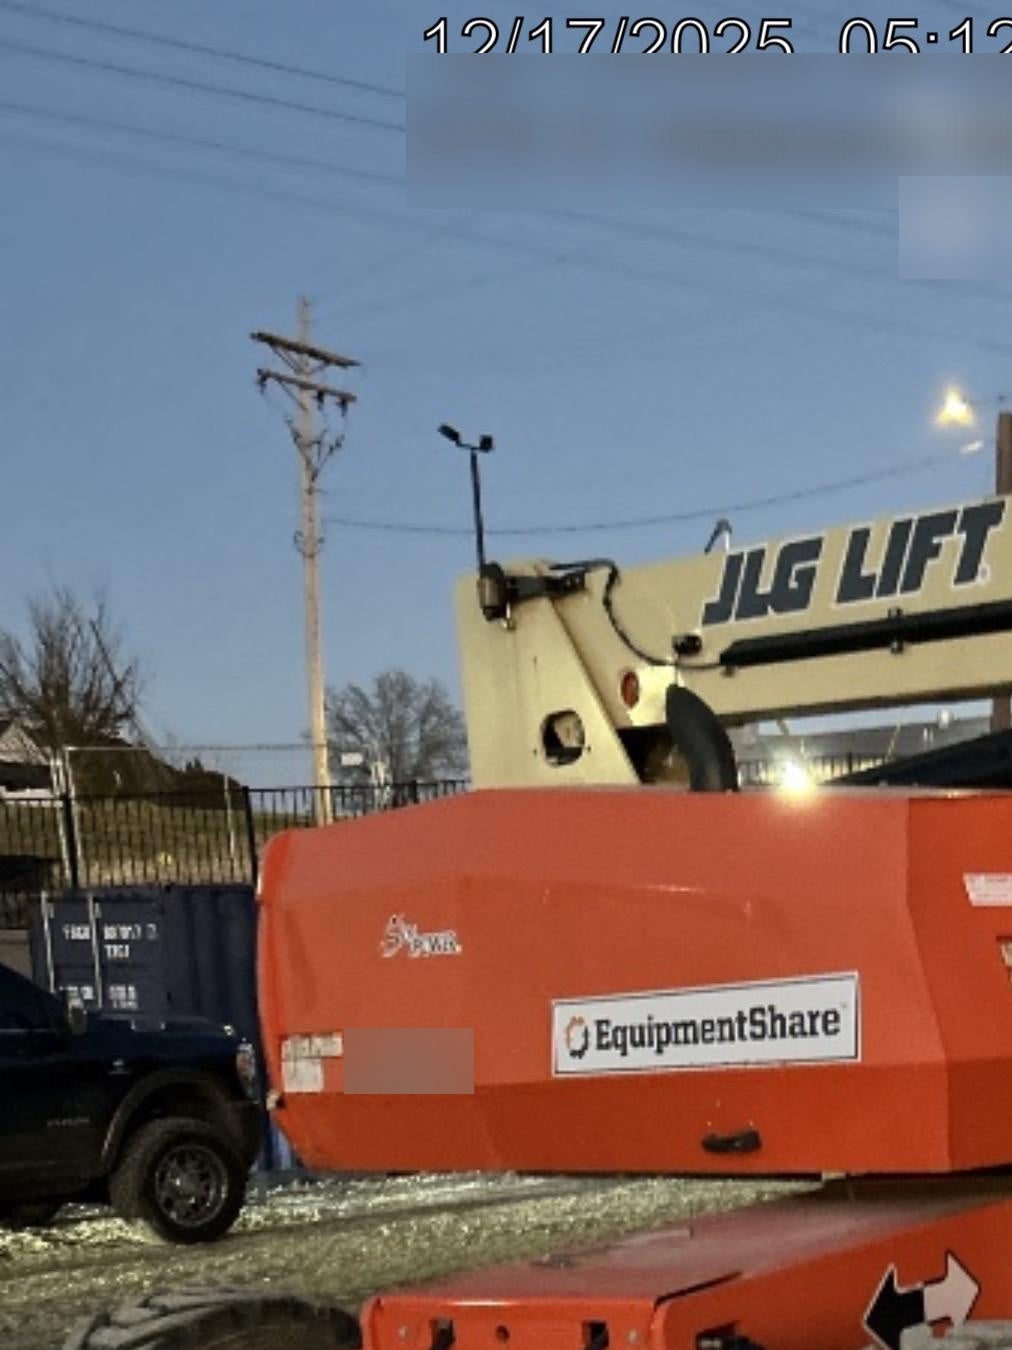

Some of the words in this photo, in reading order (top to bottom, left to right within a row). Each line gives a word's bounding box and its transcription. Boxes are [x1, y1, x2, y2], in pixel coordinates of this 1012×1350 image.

[701, 535, 825, 626] JLG
[834, 499, 1006, 605] LIFT
[595, 1004, 842, 1057] EquipmentShare
